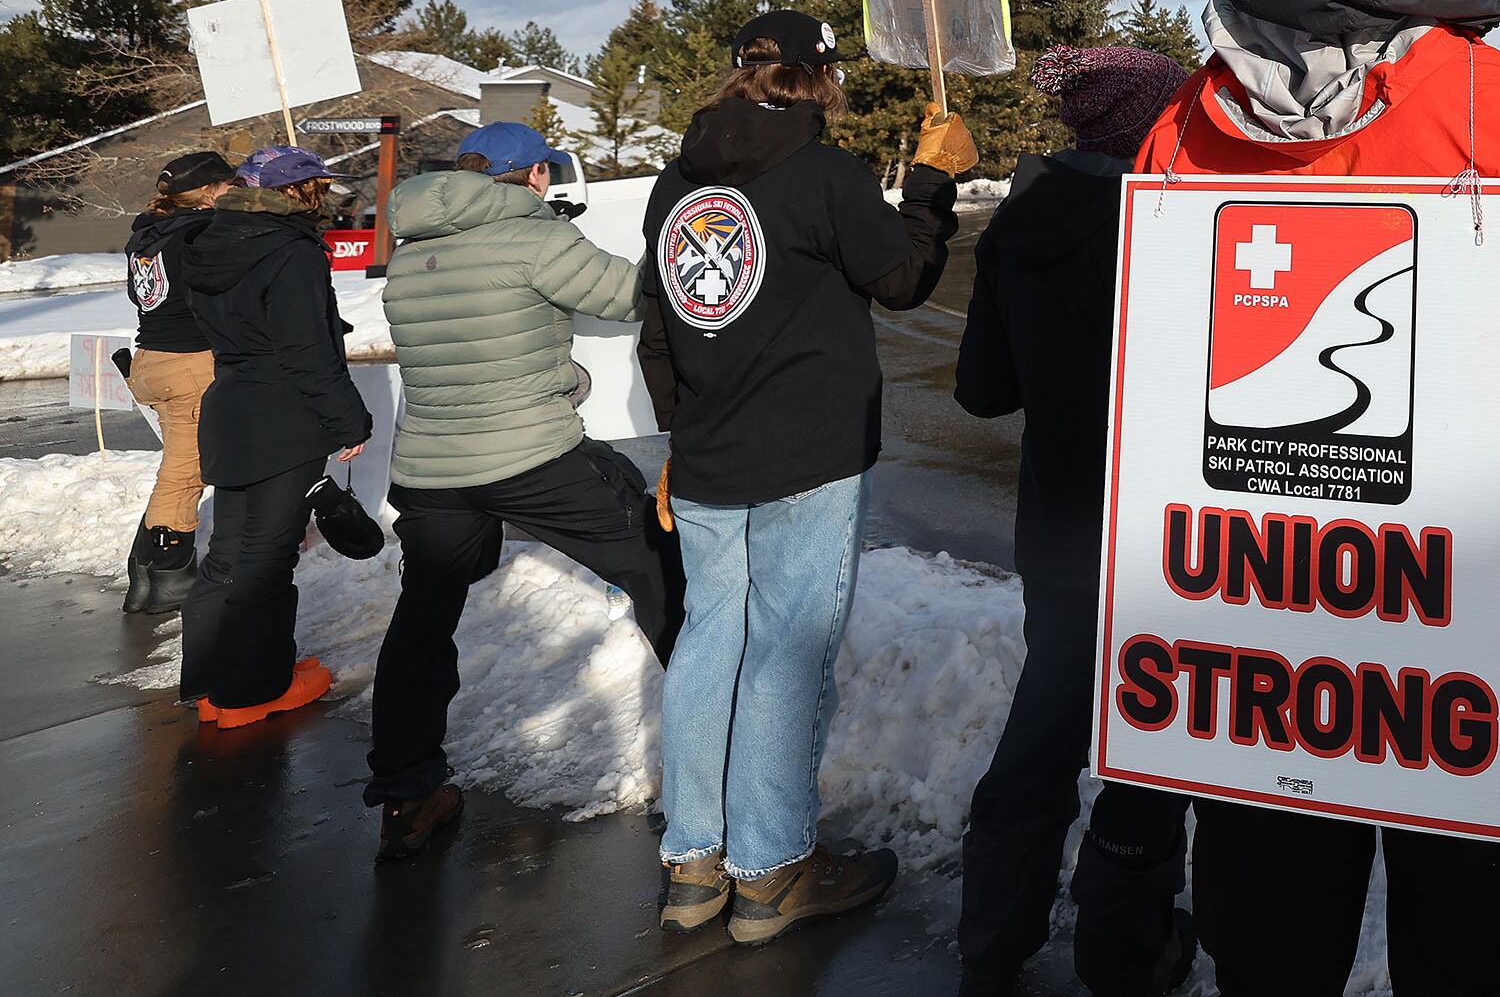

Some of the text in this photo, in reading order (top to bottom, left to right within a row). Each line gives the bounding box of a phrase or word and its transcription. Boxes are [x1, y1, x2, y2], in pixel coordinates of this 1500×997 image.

[306, 121, 364, 131] FROSTWOOD
[668, 234, 677, 258] UNITED
[712, 200, 723, 208] SKI
[333, 241, 369, 258] DXT
[693, 304, 715, 315] LOCAL
[1233, 294, 1289, 308] PCPSPA
[1207, 436, 1407, 464] PARK CITY PROFESSIONAL
[1208, 456, 1404, 485] SKI PATROL ASSOCIATION
[1247, 477, 1361, 501] CWA Local 7781
[1164, 504, 1452, 626] UNION
[1117, 634, 1498, 774] STRONG
